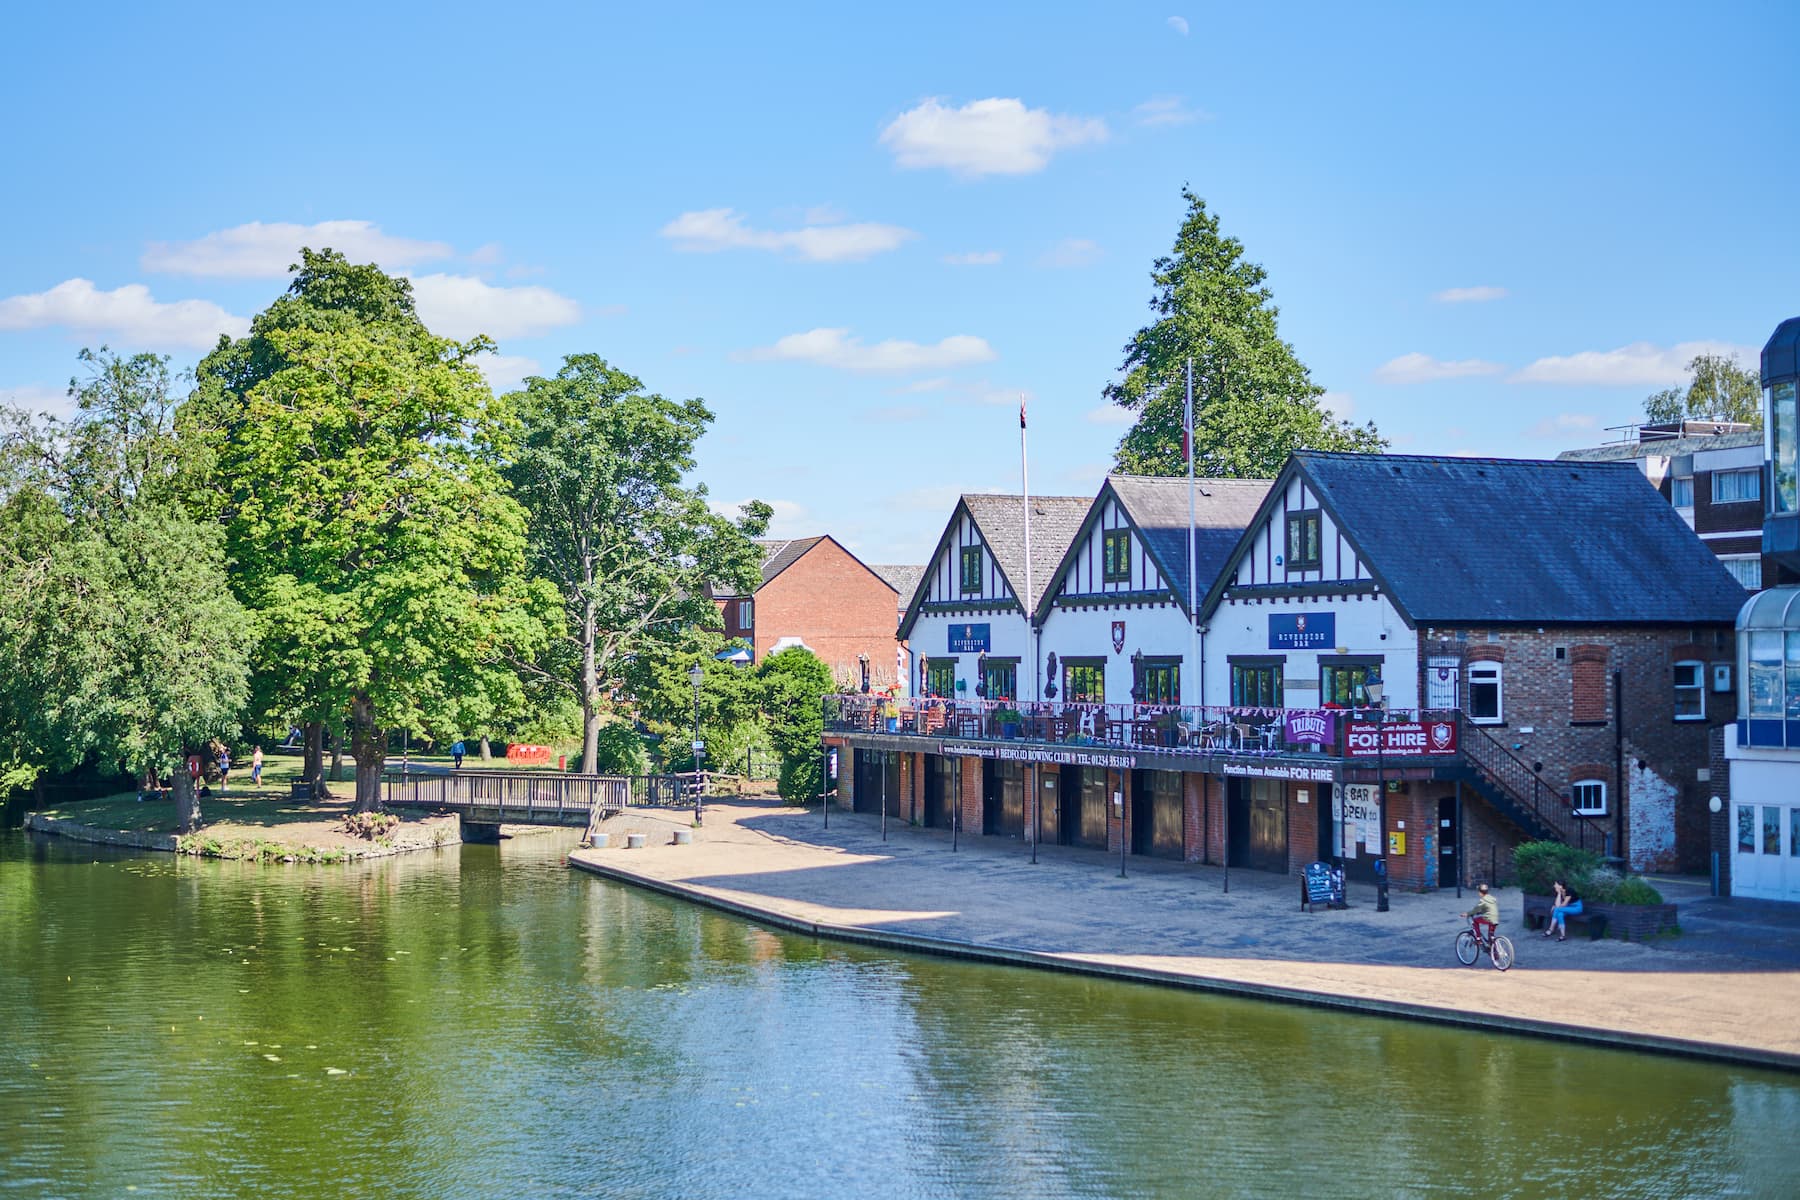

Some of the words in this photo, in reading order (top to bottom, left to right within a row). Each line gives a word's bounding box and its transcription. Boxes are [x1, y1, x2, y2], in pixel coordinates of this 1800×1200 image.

[1278, 633, 1325, 641] RIVERSIDE
[1293, 640, 1309, 648] BAR
[1290, 717, 1326, 734] TRIBUTE
[1387, 733, 1427, 747] HIRE
[1000, 748, 1028, 760] BEDFORD
[1028, 749, 1053, 762] ROWING
[1053, 752, 1071, 763] CLUB
[1077, 753, 1091, 764] TEL:
[1091, 754, 1108, 767] 01234
[1223, 763, 1246, 775] Function
[1247, 765, 1263, 776] Room
[1264, 766, 1289, 778] Available
[1290, 767, 1309, 779] FOR
[1311, 768, 1333, 781] HIRE
[1350, 787, 1369, 801] BAR
[1343, 804, 1367, 820] OPEN
